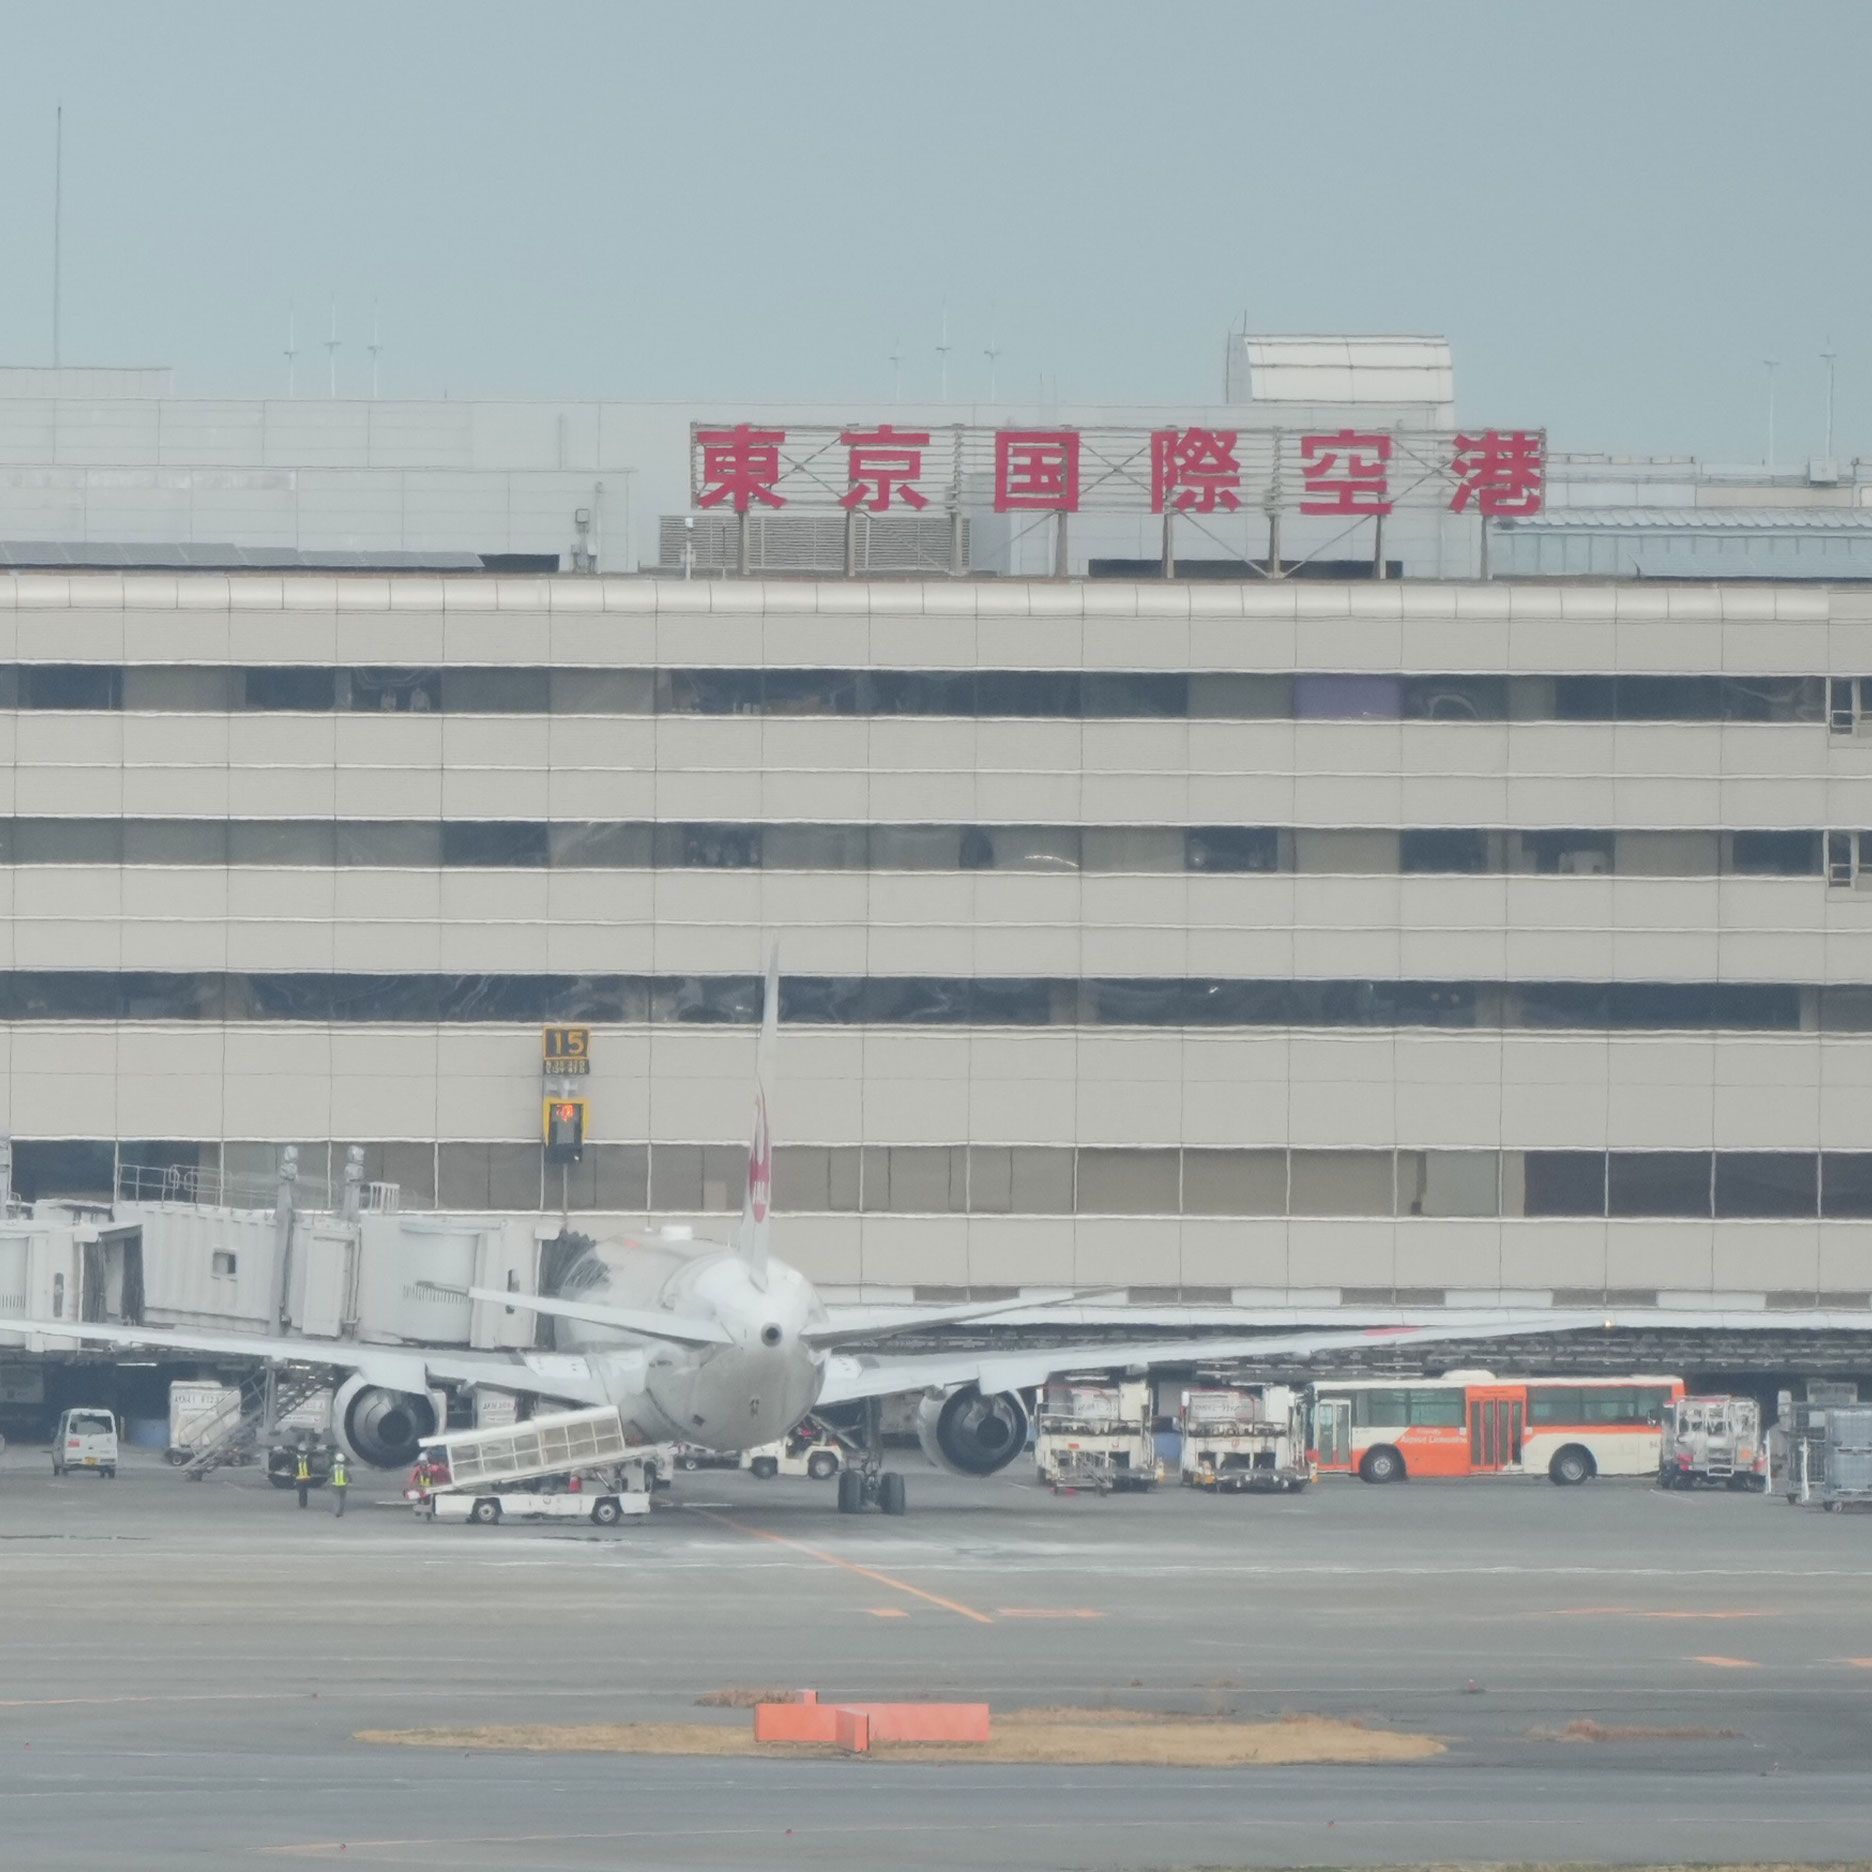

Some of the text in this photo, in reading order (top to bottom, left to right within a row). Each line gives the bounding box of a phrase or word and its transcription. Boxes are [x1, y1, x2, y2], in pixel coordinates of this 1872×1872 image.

[697, 423, 1545, 516] 東京国際空港
[555, 1031, 585, 1055] 15
